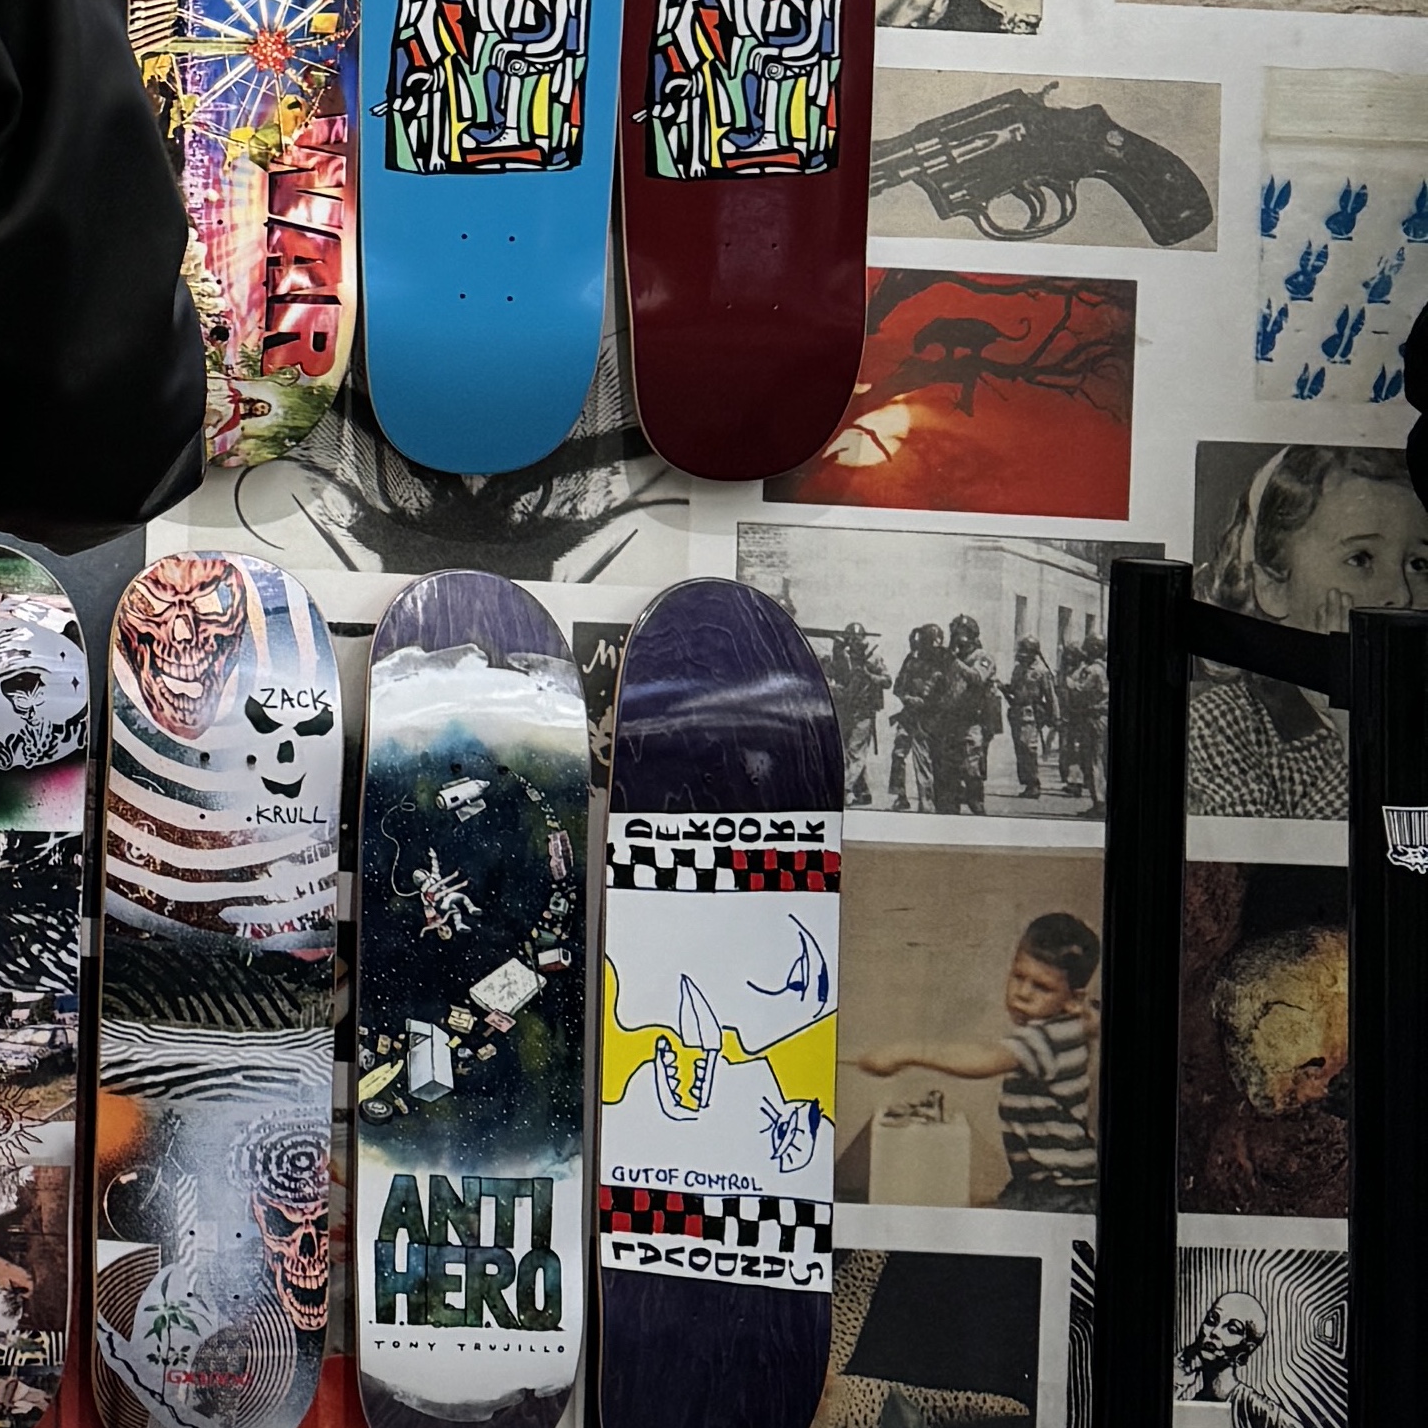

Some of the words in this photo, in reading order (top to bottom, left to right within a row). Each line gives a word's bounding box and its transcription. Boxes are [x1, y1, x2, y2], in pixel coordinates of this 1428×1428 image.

[262, 113, 349, 380] WAR
[260, 688, 332, 710] ZACK
[255, 805, 327, 824] KRULL
[684, 1171, 763, 1191] CONTROL
[378, 1174, 554, 1248] ANTI
[374, 1239, 563, 1331] HERO
[375, 1340, 436, 1351] TONY
[457, 1342, 566, 1354] TRUJILLO
